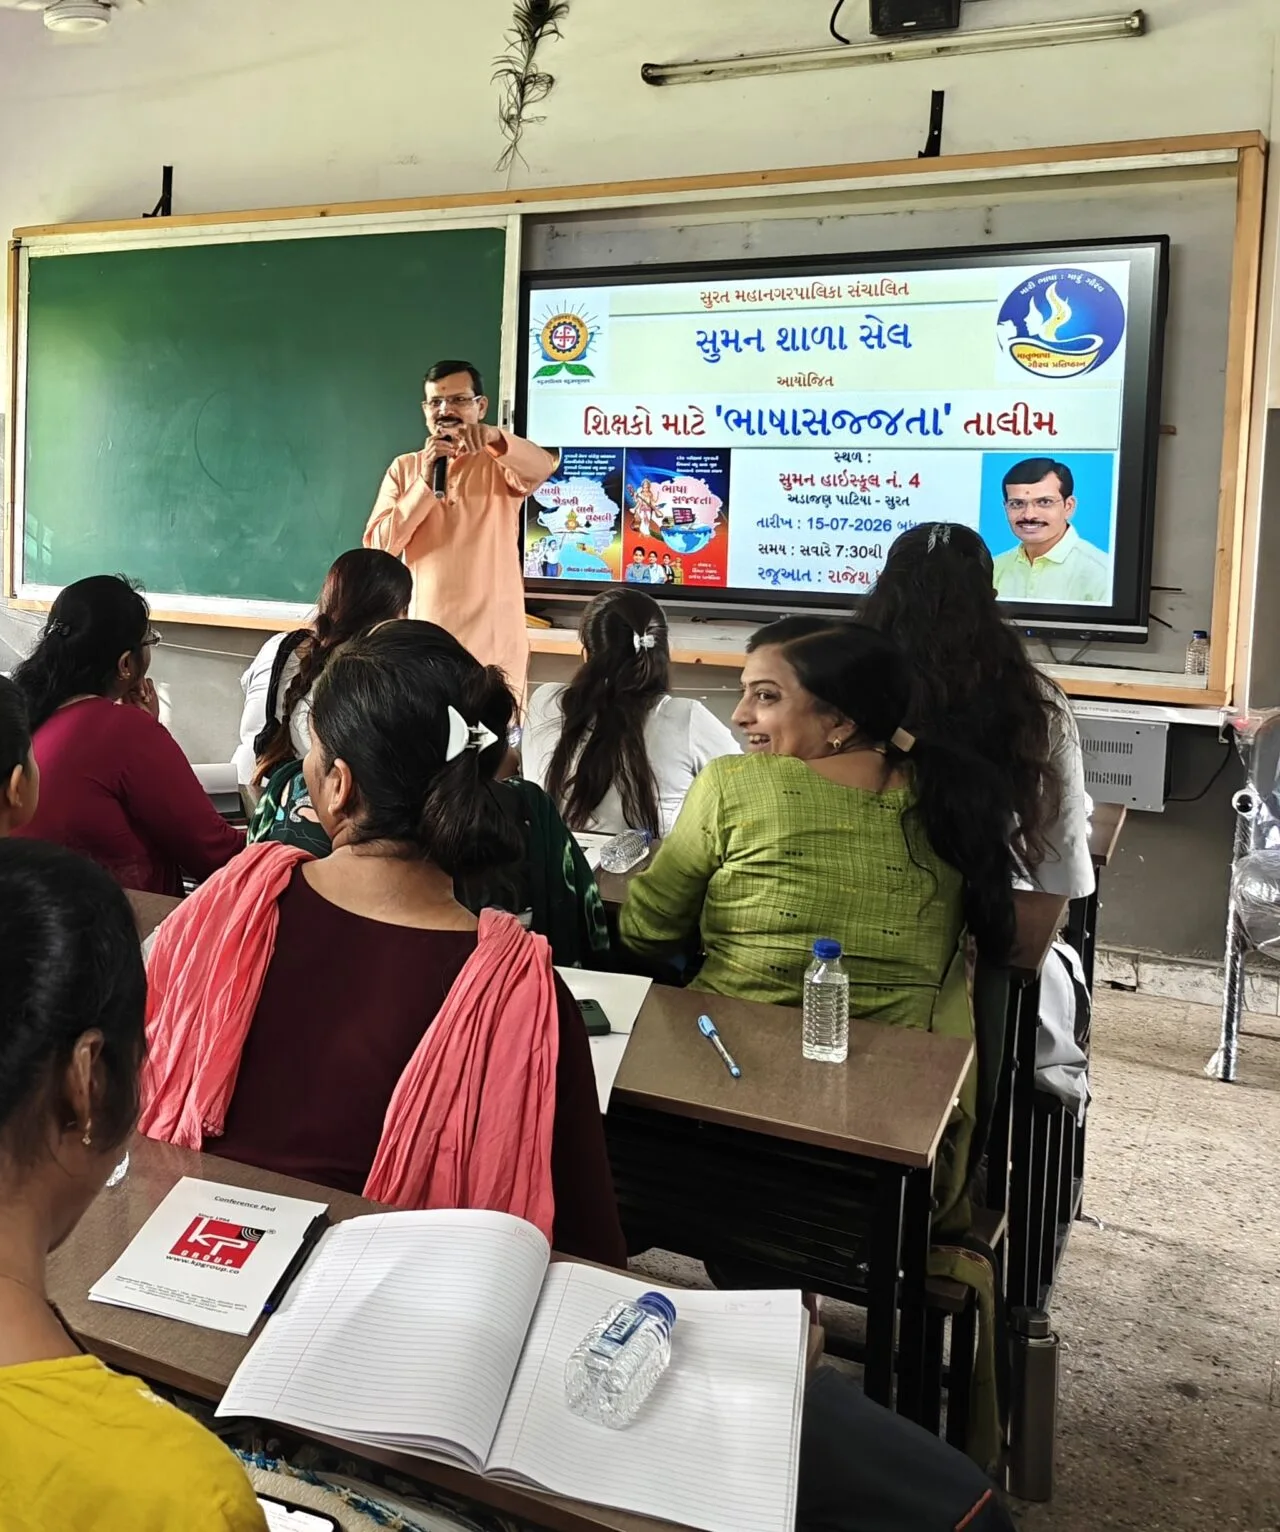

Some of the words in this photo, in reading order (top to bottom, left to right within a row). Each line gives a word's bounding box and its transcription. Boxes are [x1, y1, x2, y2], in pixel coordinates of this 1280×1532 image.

[700, 289, 730, 308] સુરત
[735, 281, 842, 302] મહાનગરપાલિકા
[847, 278, 910, 298] સંચાલિત
[696, 327, 765, 363] સુમન
[776, 324, 848, 351] શાળા
[859, 314, 912, 349] સેલ
[777, 372, 834, 387] આયોજિત
[584, 405, 653, 436] શિક્ષકો
[662, 405, 706, 436] માટે
[963, 402, 1058, 436] તાલીમ
[834, 451, 863, 463] સ્થળ
[662, 485, 687, 494] ભાષા
[779, 473, 815, 491] સુમન
[909, 473, 920, 488] 4
[787, 494, 832, 508] અડાજણ
[836, 492, 872, 506] પાટિયા
[885, 495, 910, 509] સુરત
[756, 513, 793, 529] તારીખ
[807, 517, 892, 532] 15-07-2026
[758, 543, 787, 556] સમય
[800, 541, 831, 557] સવારે
[757, 567, 812, 585] રજૂઆત
[828, 565, 871, 585] રાજેશ
[214, 1195, 259, 1209] Conference
[165, 1254, 240, 1275] www.kpgroup.co
[180, 1249, 234, 1266] GROUP
